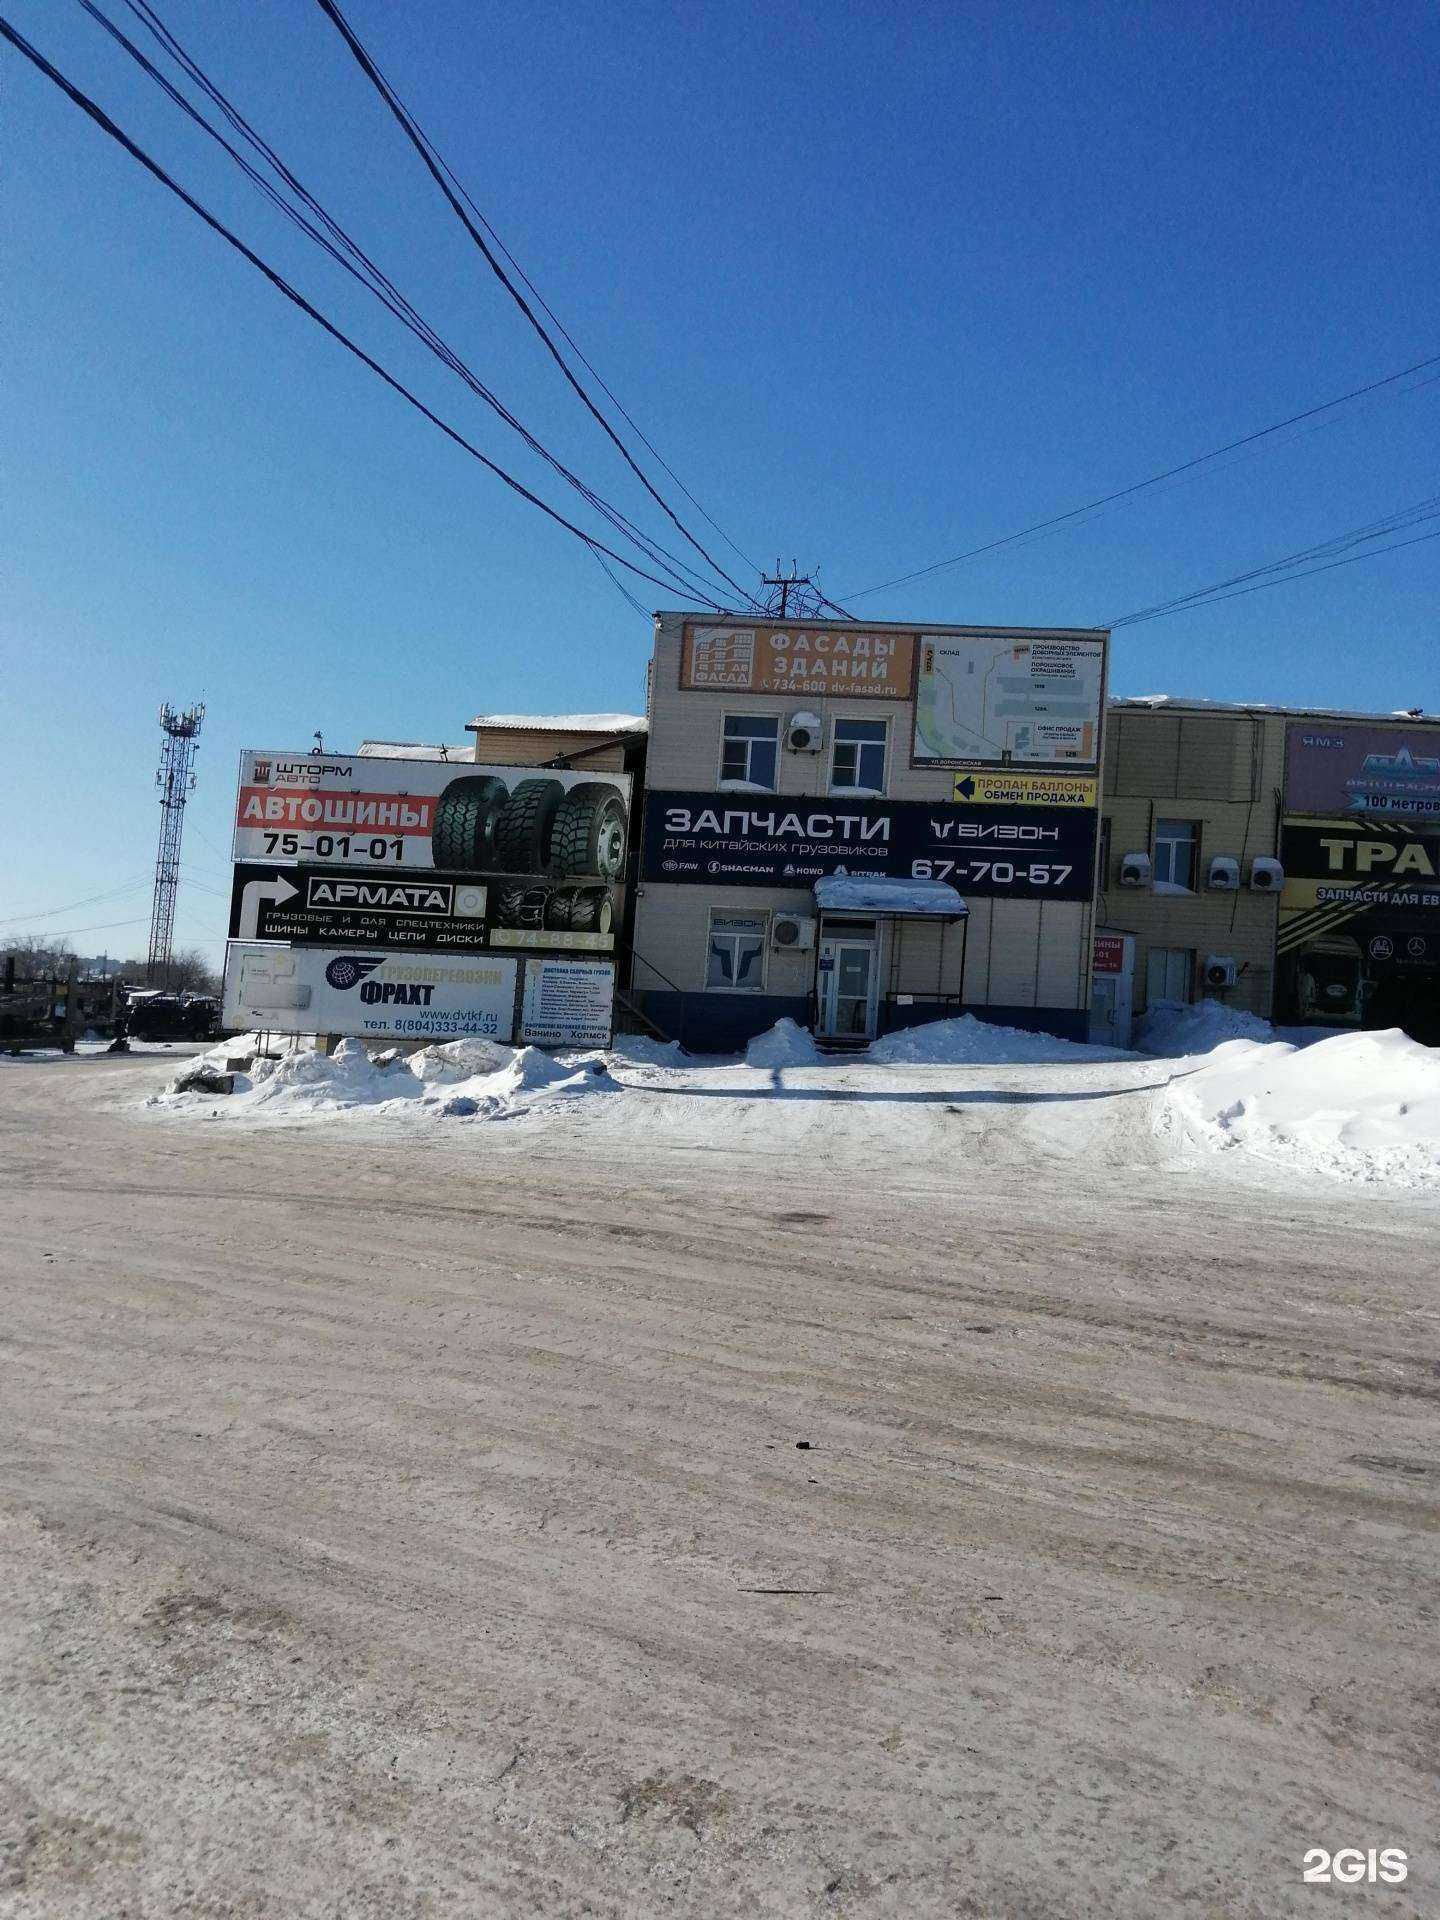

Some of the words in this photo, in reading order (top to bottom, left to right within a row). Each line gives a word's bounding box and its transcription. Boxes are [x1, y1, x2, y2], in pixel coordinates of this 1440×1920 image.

[769, 632, 896, 657] ФАСАДЫ
[773, 656, 888, 679] ЗДАНИЙ
[695, 671, 748, 683] ФАСАД
[276, 762, 352, 777] ШТОРМ
[274, 774, 321, 784] АВТО
[977, 778, 1028, 790] ПРОПАН
[1031, 779, 1093, 793] БАЛЛОНЫ
[984, 790, 1023, 801] ОБМЕН
[1026, 792, 1085, 803] ПРОДАЖА
[1364, 795, 1387, 808] 100
[1391, 798, 1440, 812] метров
[243, 795, 429, 828] АВТОШИНЫ
[664, 808, 890, 841] ЗАПЧАСТИ
[958, 823, 1059, 841] БИЗОН
[263, 832, 404, 861] 75-01-01
[700, 839, 787, 852] китайских
[791, 843, 888, 857] грузовиков
[679, 862, 698, 870] FAW
[720, 864, 774, 873] SHACMAN
[796, 867, 824, 875] HOWO
[911, 859, 1073, 885] 67-70-57
[312, 883, 446, 909] АРМАТА
[1317, 888, 1389, 903] ЗАПЧАСТИ
[1391, 893, 1419, 905] ДЛЯ
[266, 912, 333, 923] ГРУЗОВЫЕ
[343, 916, 352, 924] И
[396, 919, 485, 931] СПЕЦТЕХНИКИ
[713, 919, 764, 928] БИЗОН
[265, 924, 309, 935] ШИНЫ
[319, 927, 378, 939] КАМЕРЫ
[388, 931, 426, 942] ЦЕПИ
[436, 934, 484, 944] ДИСКИ
[360, 980, 435, 1006] ФРАХТ
[419, 1009, 498, 1022] www.dvtkf.ru
[364, 1020, 390, 1030] тел.
[394, 1020, 498, 1034] 8(804)333-44-32
[524, 1028, 562, 1038] Ванино
[570, 1030, 607, 1040] Холмск
